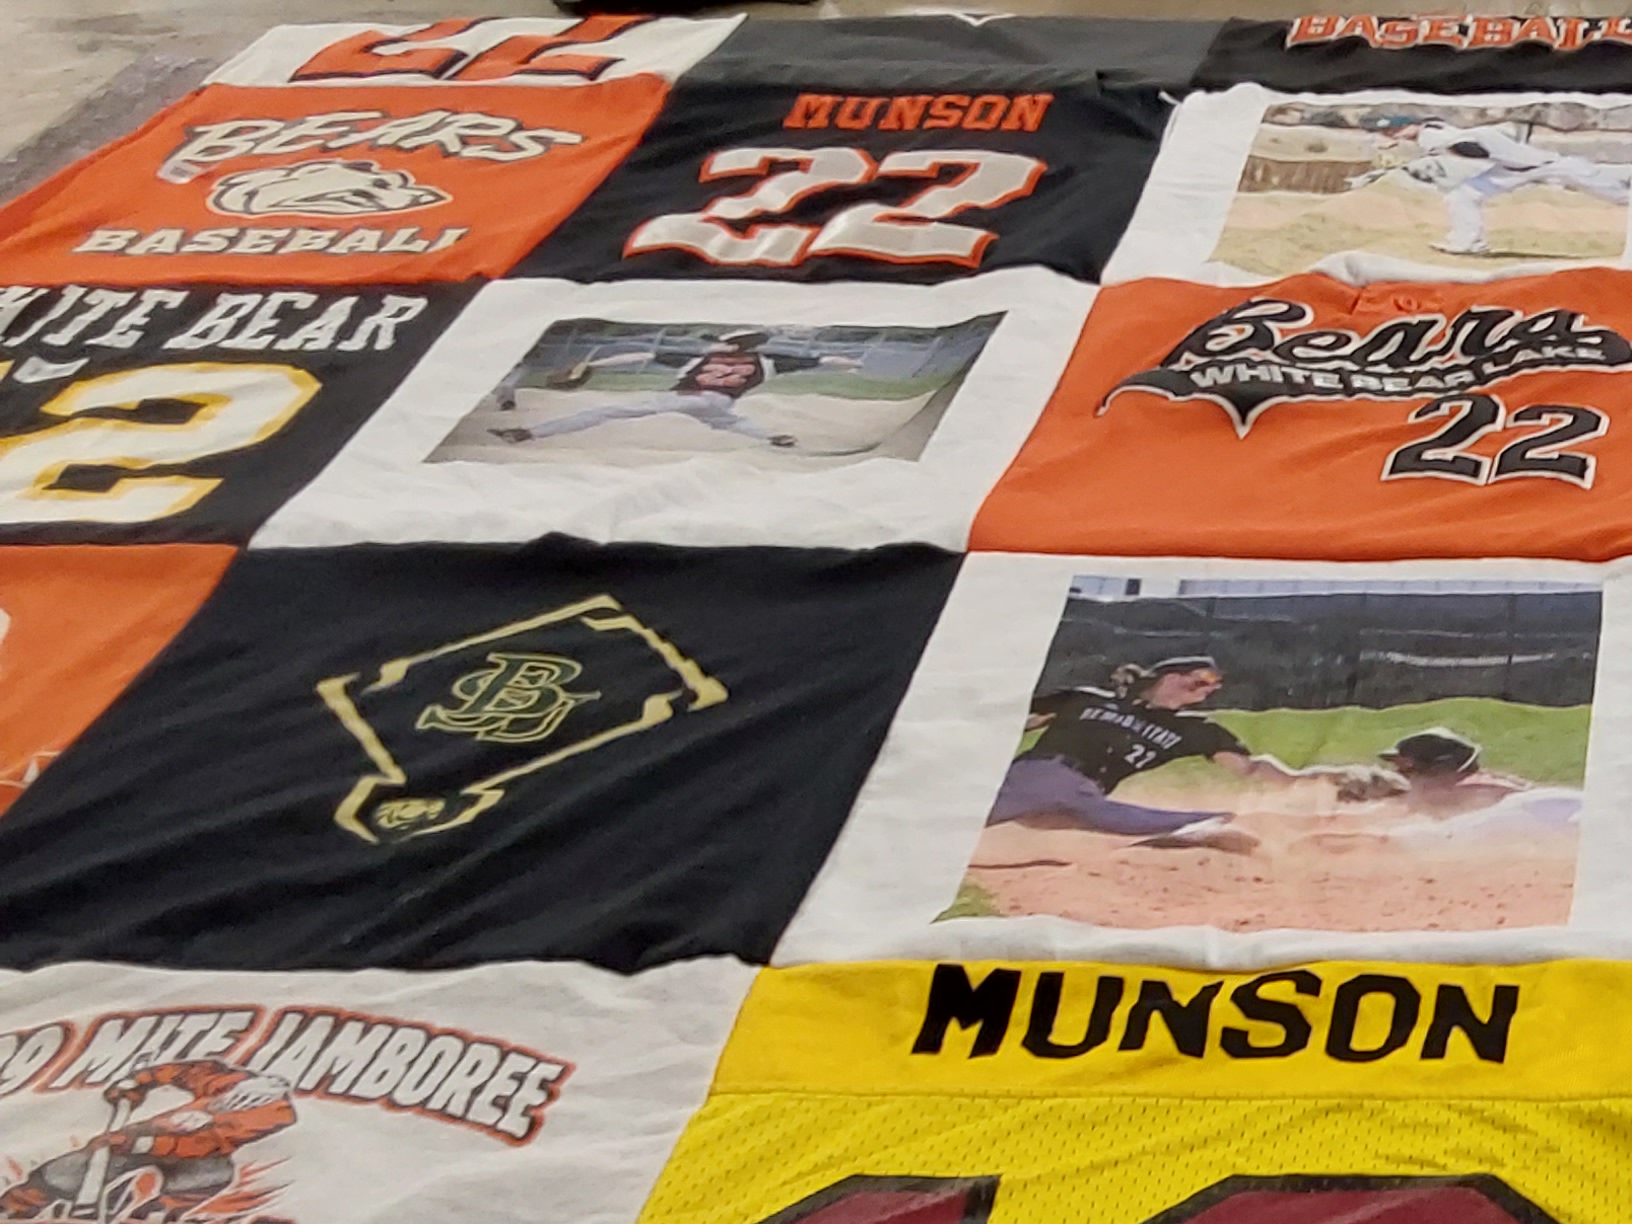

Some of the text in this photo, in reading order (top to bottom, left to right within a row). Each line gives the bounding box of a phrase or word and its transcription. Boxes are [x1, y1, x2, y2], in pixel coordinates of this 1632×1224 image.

[183, 108, 588, 163] BEARS
[783, 92, 1053, 132] MUNSON
[622, 146, 1048, 269] 22
[162, 290, 428, 352] BEAR
[1191, 345, 1606, 393] WHITE BEAR LAKE
[0, 360, 323, 525] 2
[1380, 393, 1610, 491] 22
[911, 963, 1520, 1065] MUNSON
[44, 1006, 262, 1090] MITE
[230, 1006, 574, 1145] JAMBOREE
